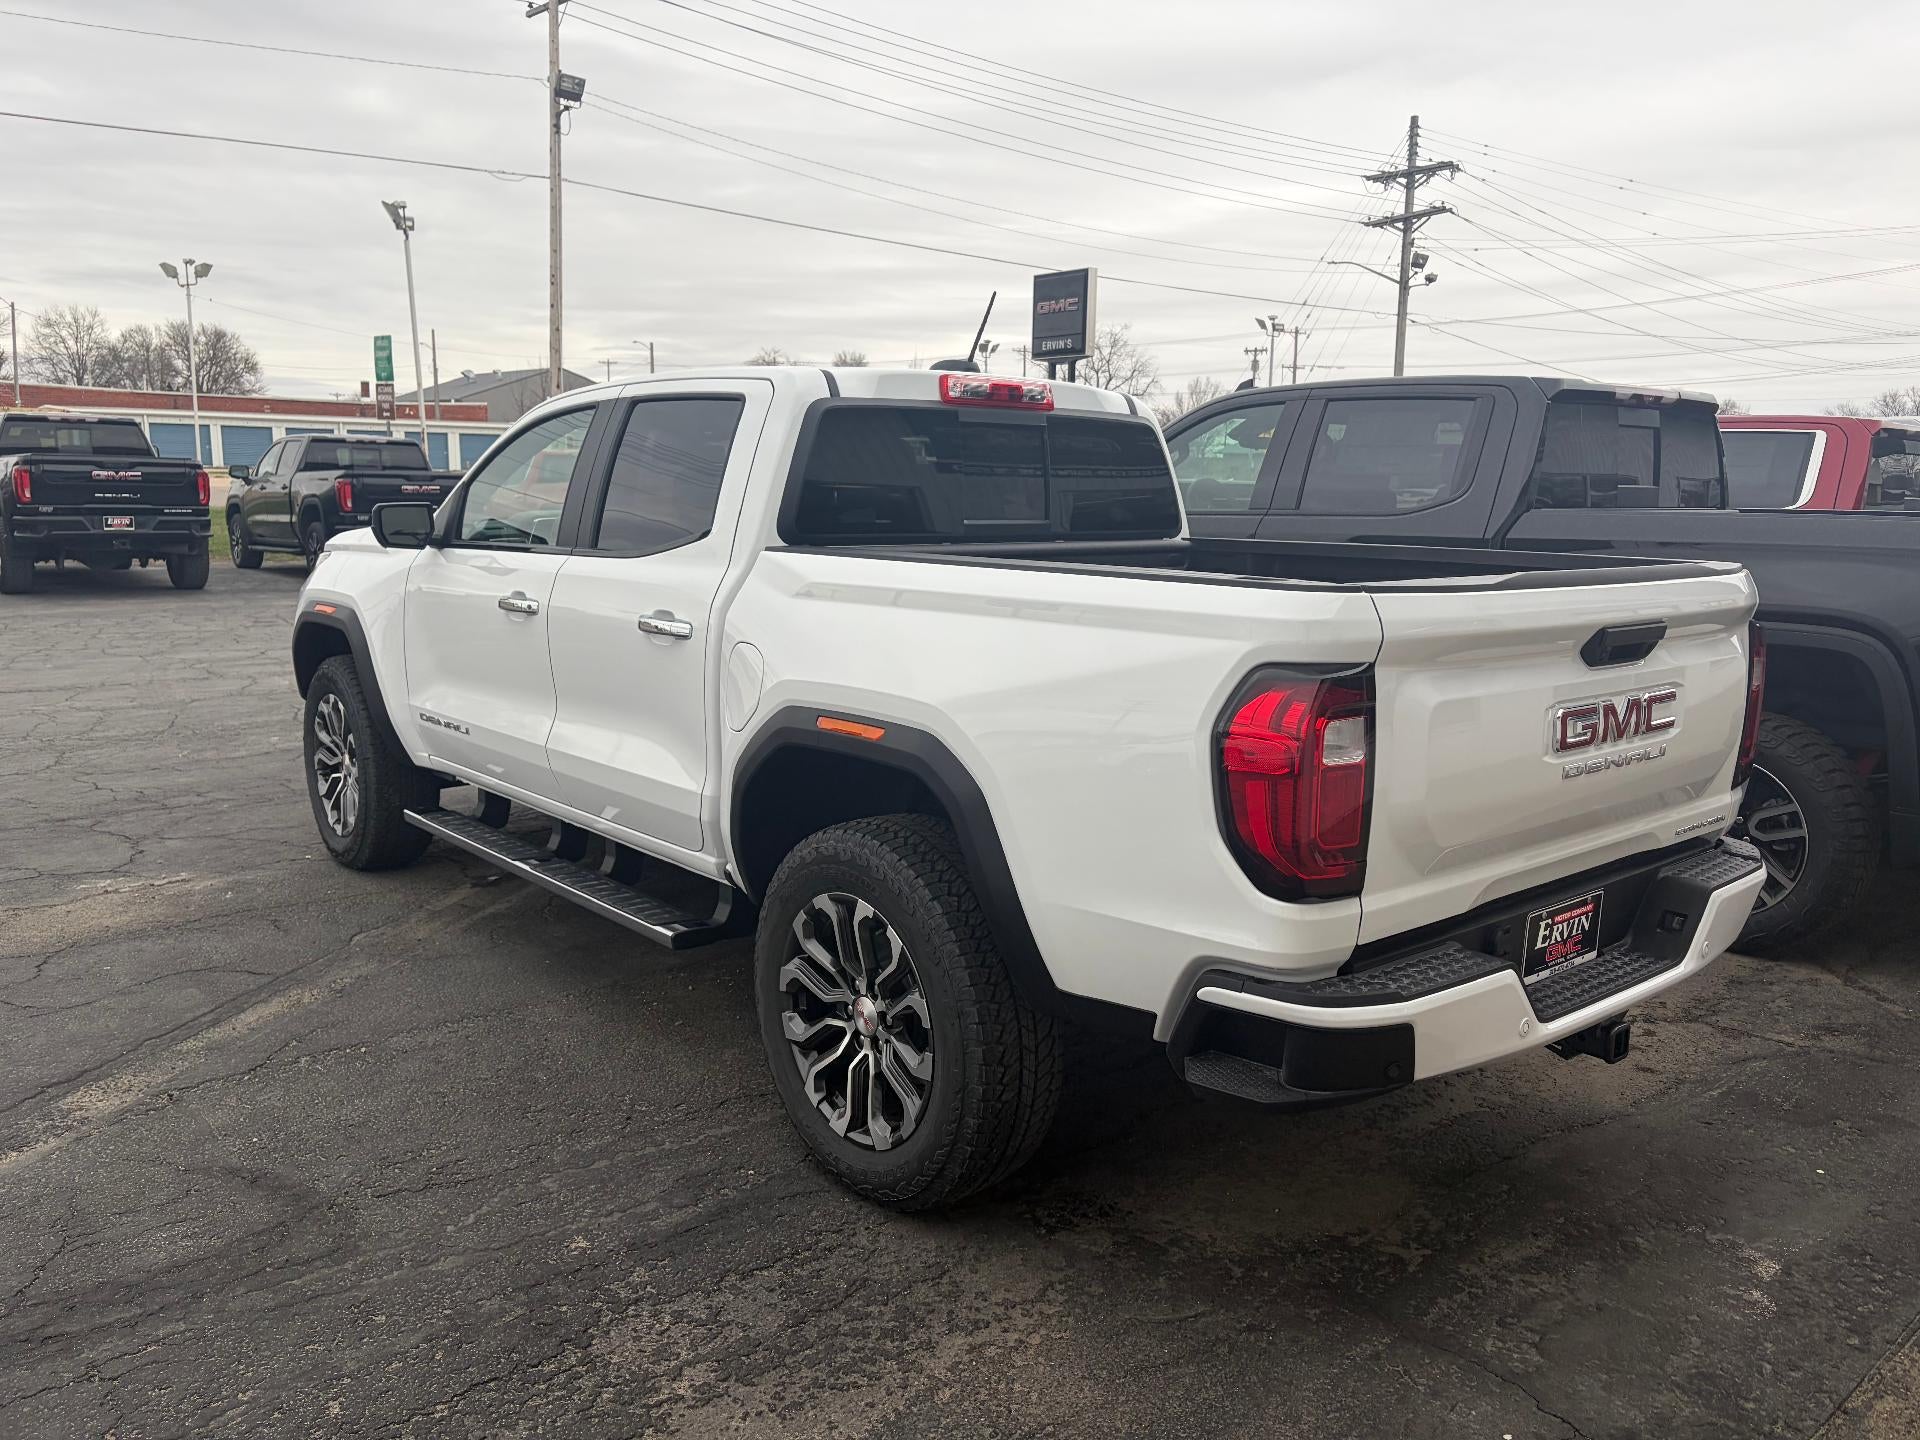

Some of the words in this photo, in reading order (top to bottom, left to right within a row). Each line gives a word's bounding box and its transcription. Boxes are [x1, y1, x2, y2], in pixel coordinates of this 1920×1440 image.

[1036, 297, 1079, 315] GMC
[1042, 339, 1073, 351] ERVIN'S
[91, 470, 142, 480] GMC
[401, 485, 441, 494] GMC
[419, 711, 471, 736] DENALI
[1552, 687, 1678, 754] GMC
[1561, 743, 1668, 780] DENALI
[1534, 912, 1593, 950] ERVIN
[1545, 934, 1583, 962] GMC
